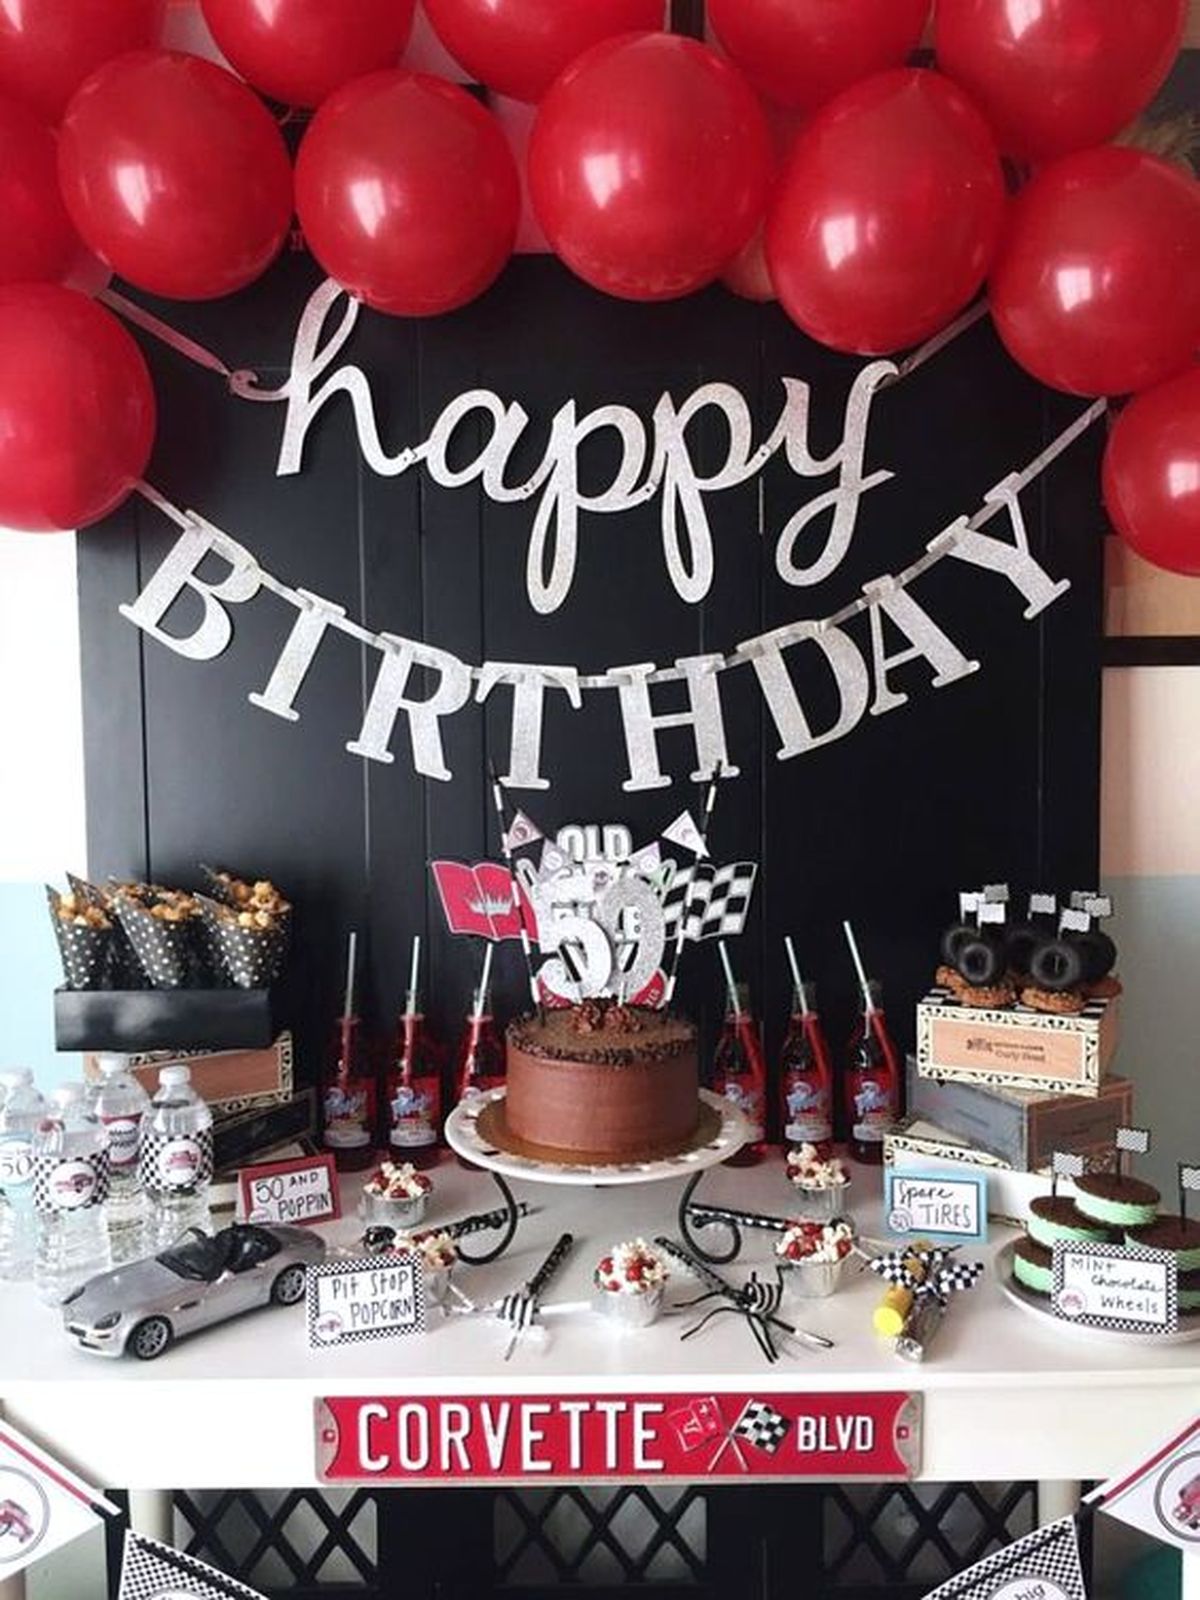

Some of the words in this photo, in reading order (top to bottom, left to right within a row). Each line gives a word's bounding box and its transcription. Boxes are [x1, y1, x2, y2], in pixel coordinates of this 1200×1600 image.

[224, 278, 899, 614] happy
[118, 472, 1071, 791] BIRTHDAY
[556, 824, 632, 863] OLD
[256, 1177, 284, 1204] 50
[290, 1172, 319, 1187] AND
[898, 1181, 953, 1208] Spare
[278, 1193, 329, 1219] POPPIN
[350, 1297, 413, 1328] POPCORN
[357, 1402, 664, 1472] CORVETTE
[797, 1415, 873, 1452] BLVD
